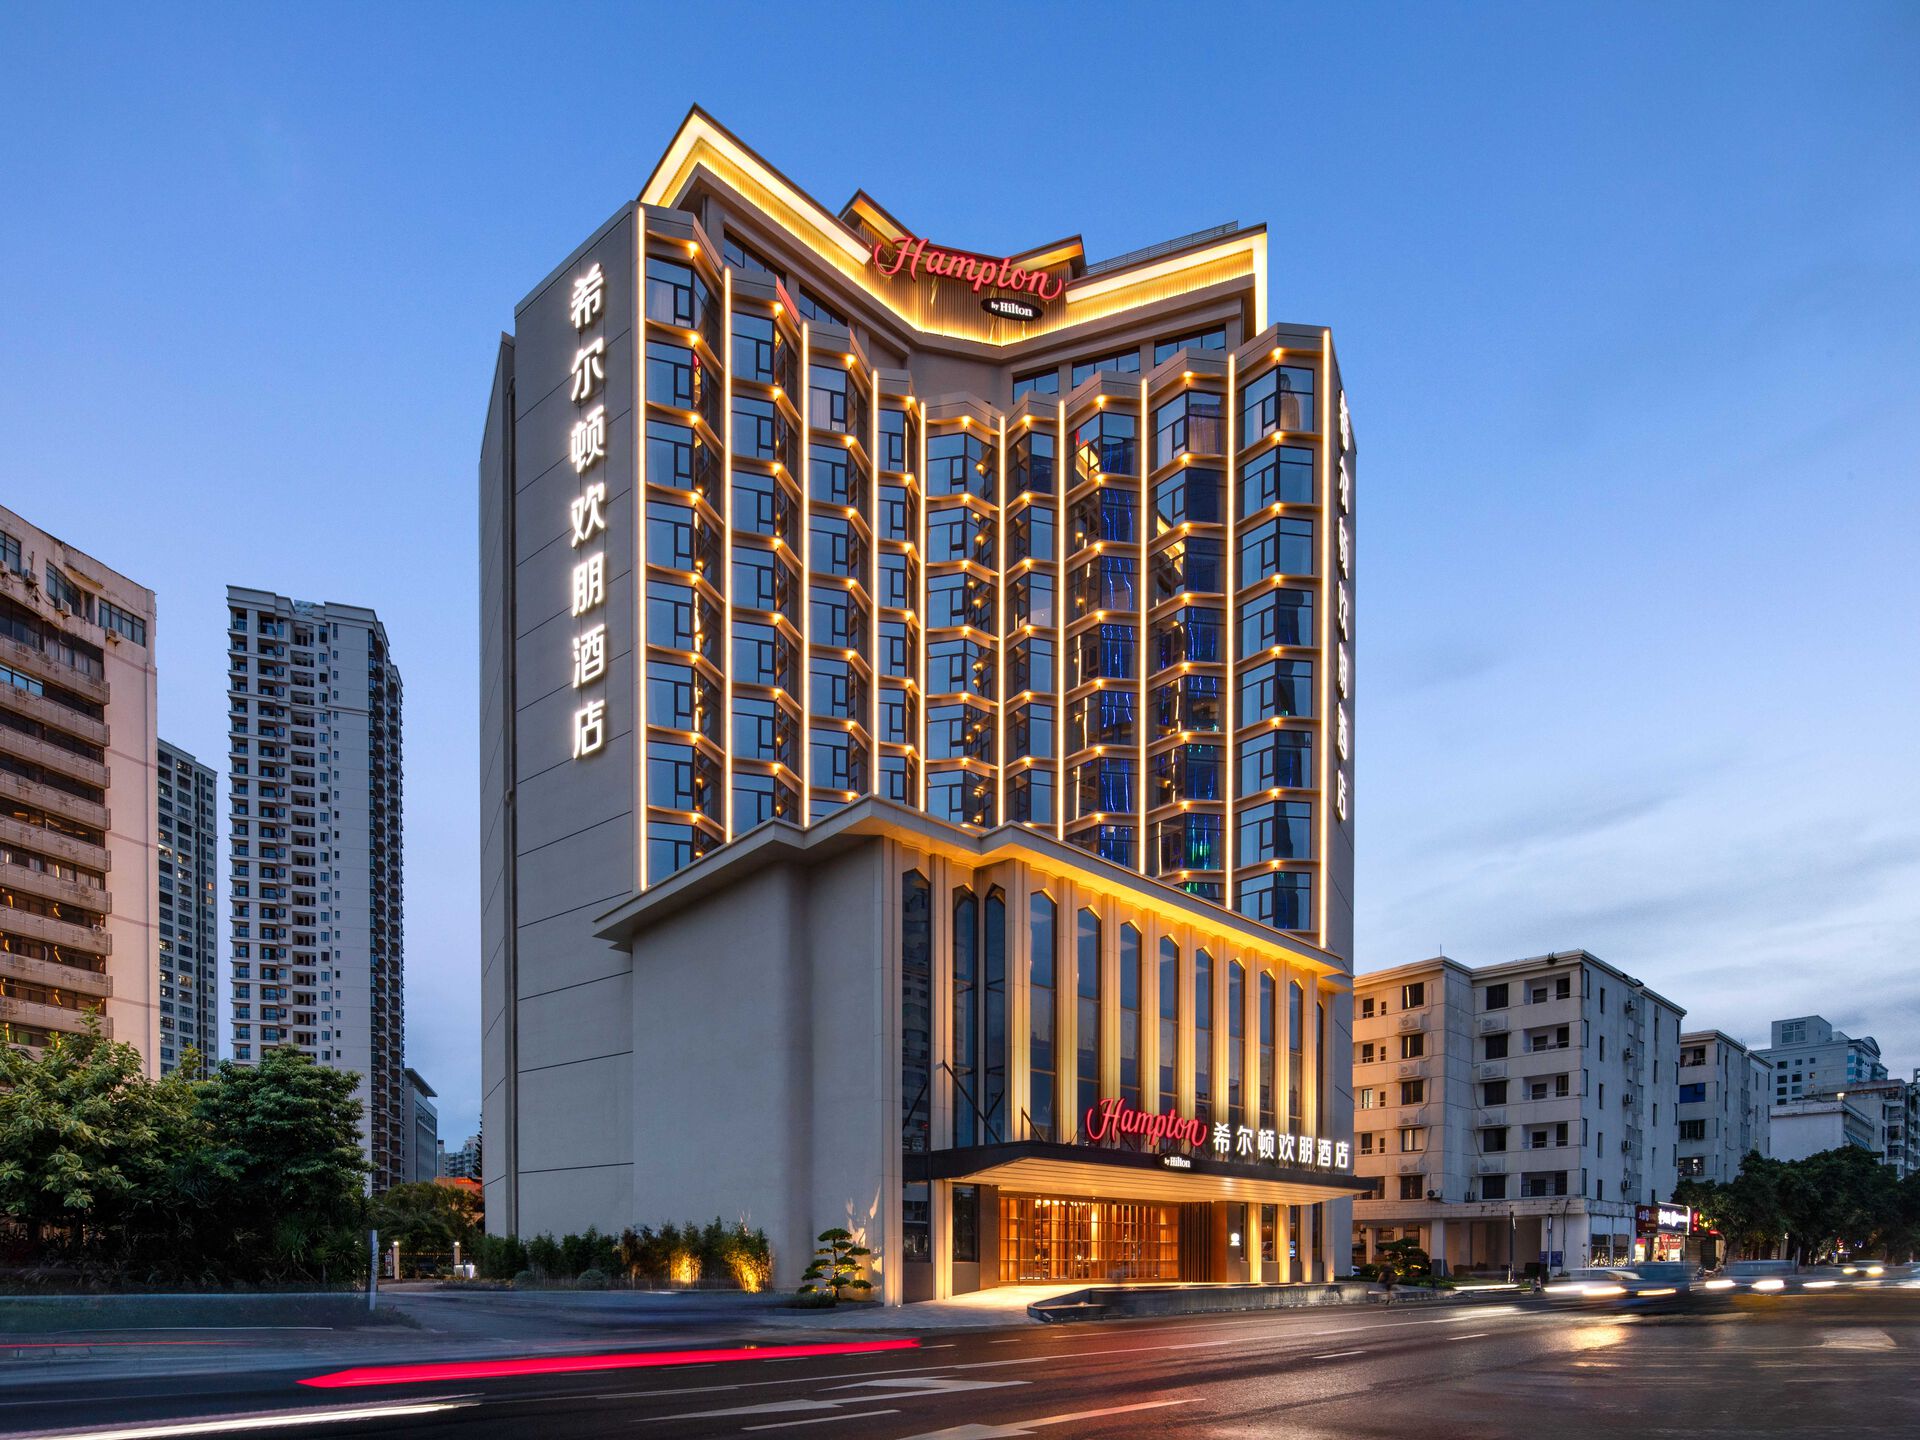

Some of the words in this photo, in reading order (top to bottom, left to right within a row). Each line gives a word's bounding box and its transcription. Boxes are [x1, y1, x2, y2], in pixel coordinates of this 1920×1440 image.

[873, 235, 1063, 300] Hampton
[991, 302, 999, 310] by
[1000, 302, 1033, 317] Hilton
[570, 263, 607, 760] 希尔顿欢朋酒店
[1086, 1097, 1207, 1146] Hampton
[1213, 1122, 1350, 1168] 希尔顿欢朋酒店
[1170, 1156, 1191, 1168] Hilton
